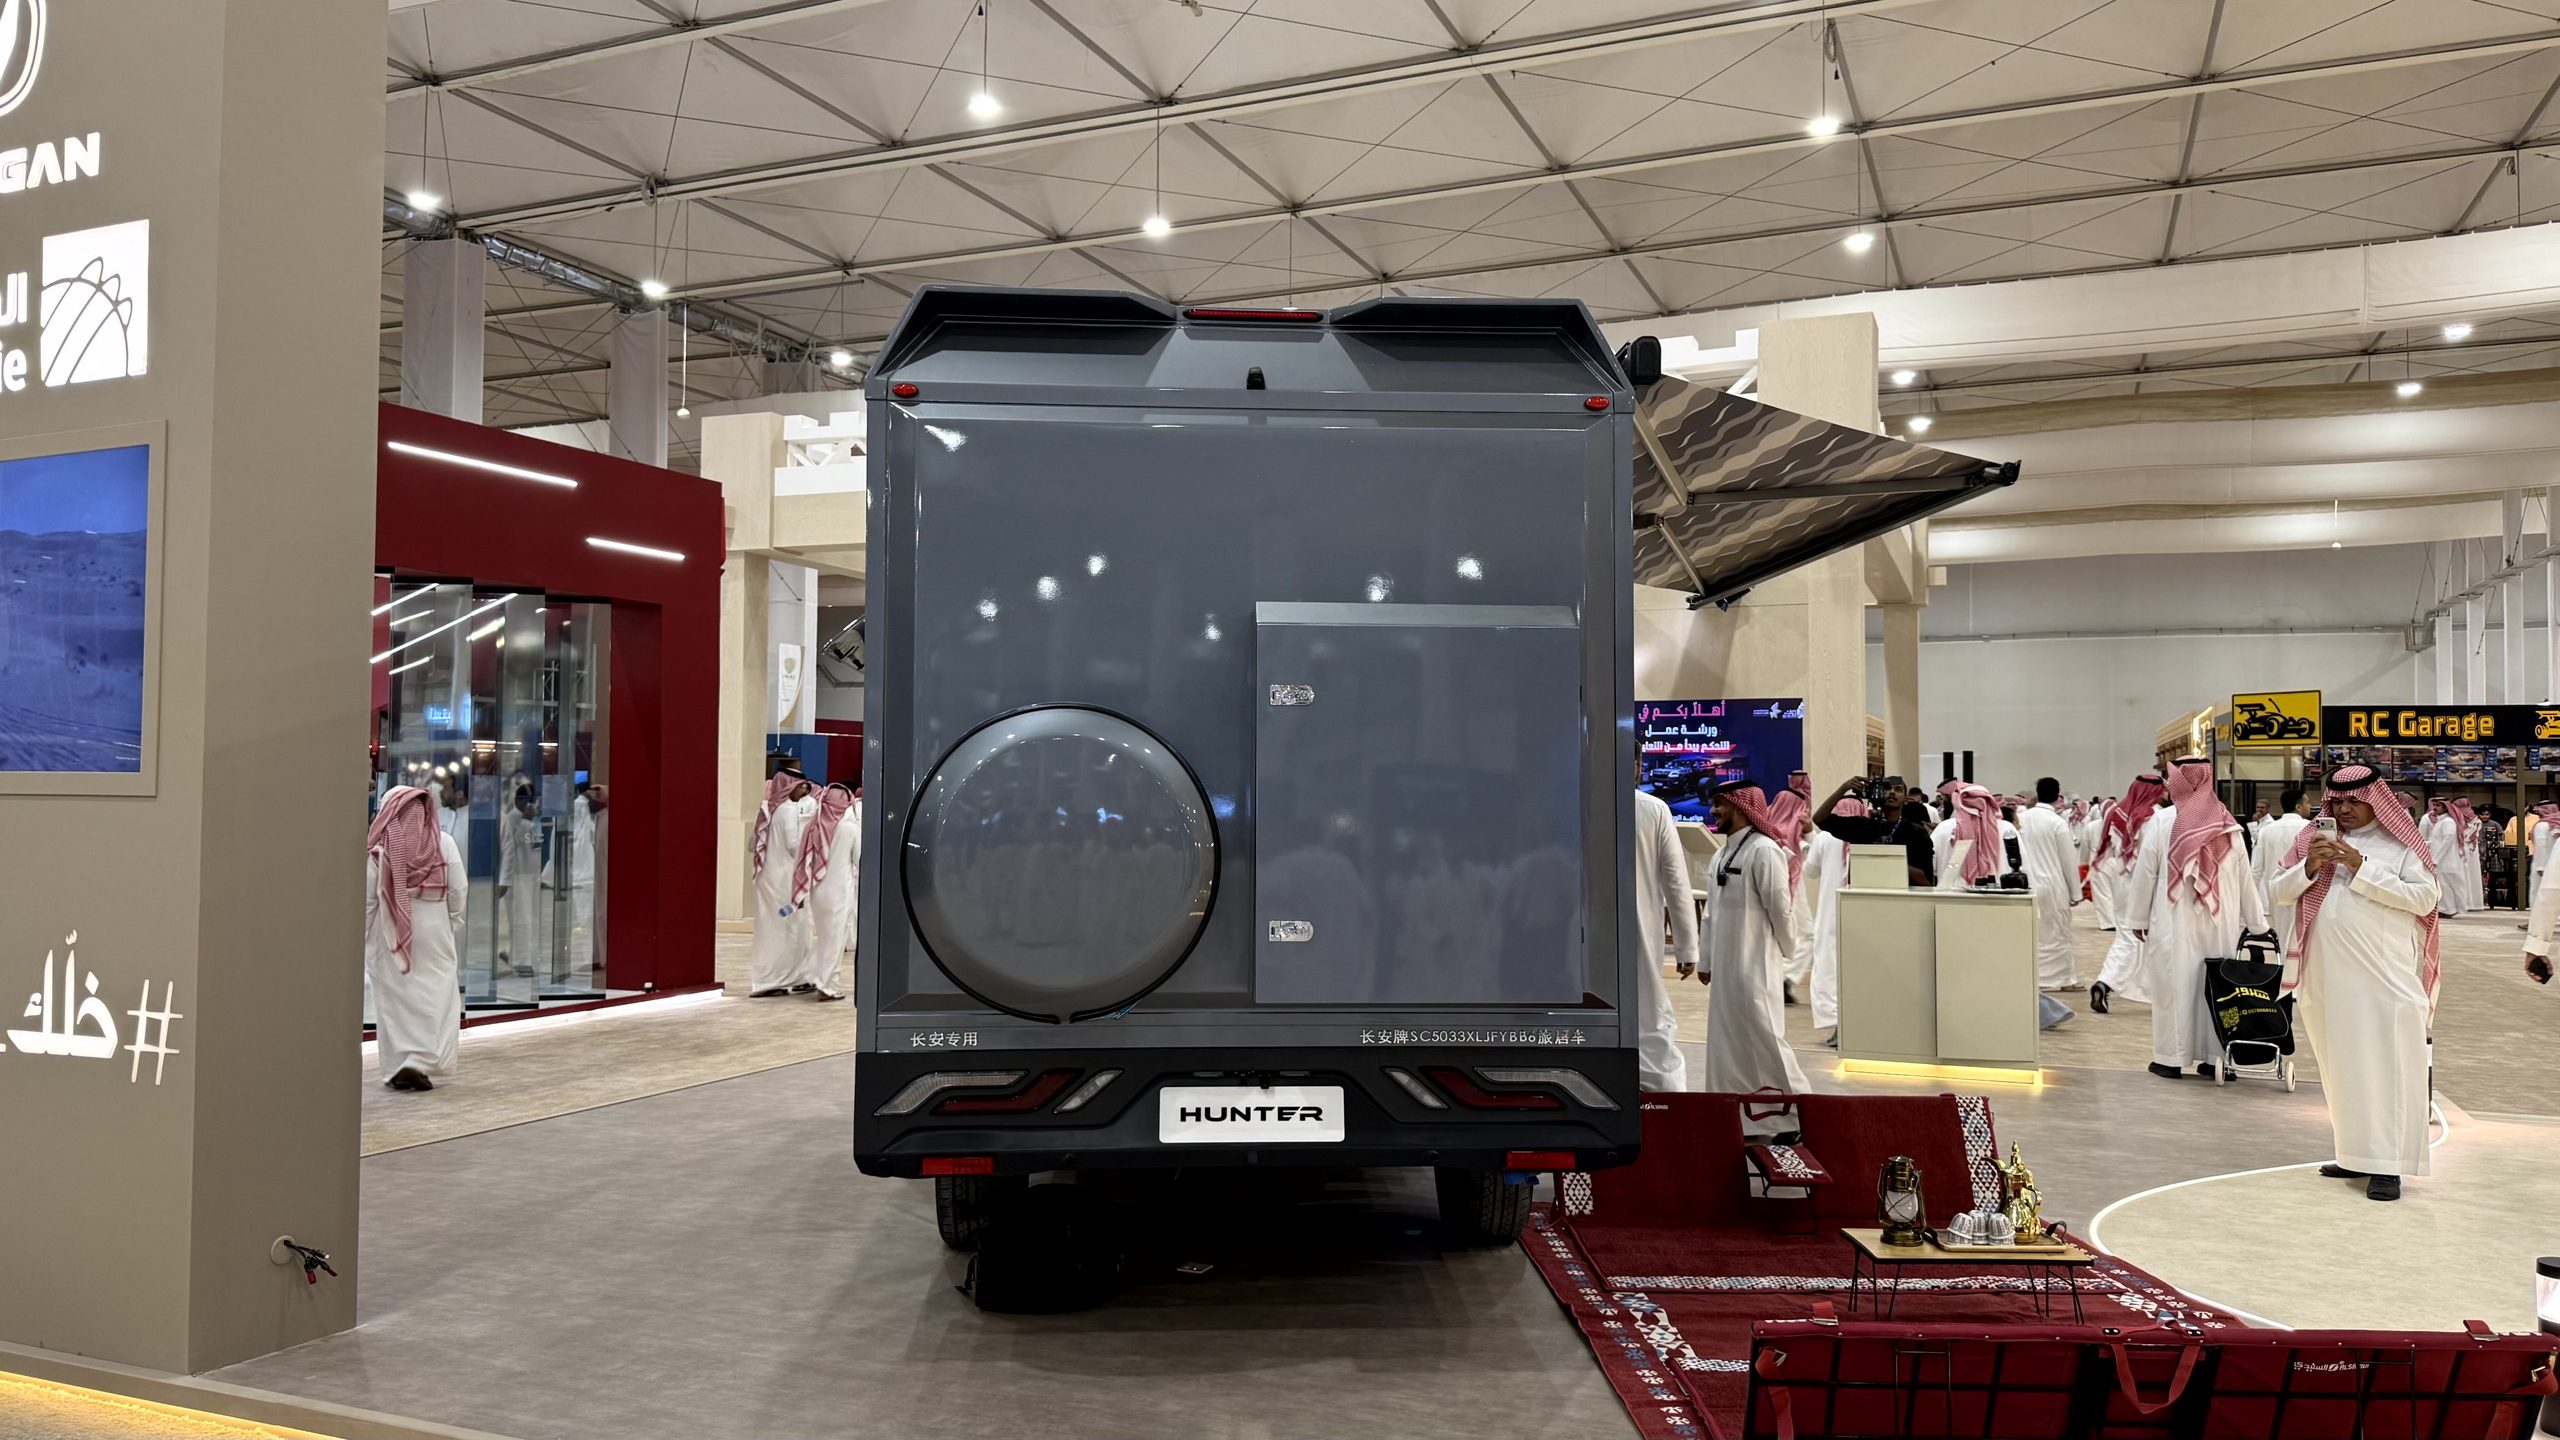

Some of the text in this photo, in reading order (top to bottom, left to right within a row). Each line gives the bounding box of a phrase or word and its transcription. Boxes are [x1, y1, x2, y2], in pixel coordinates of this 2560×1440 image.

[1638, 703, 1650, 723] في
[1652, 704, 1688, 721] بكم
[1645, 723, 1718, 738] ورشة عمل
[2349, 710, 2495, 742] RC Garage
[910, 1031, 978, 1047] 长安专用
[1180, 1106, 1324, 1123] HUNTER
